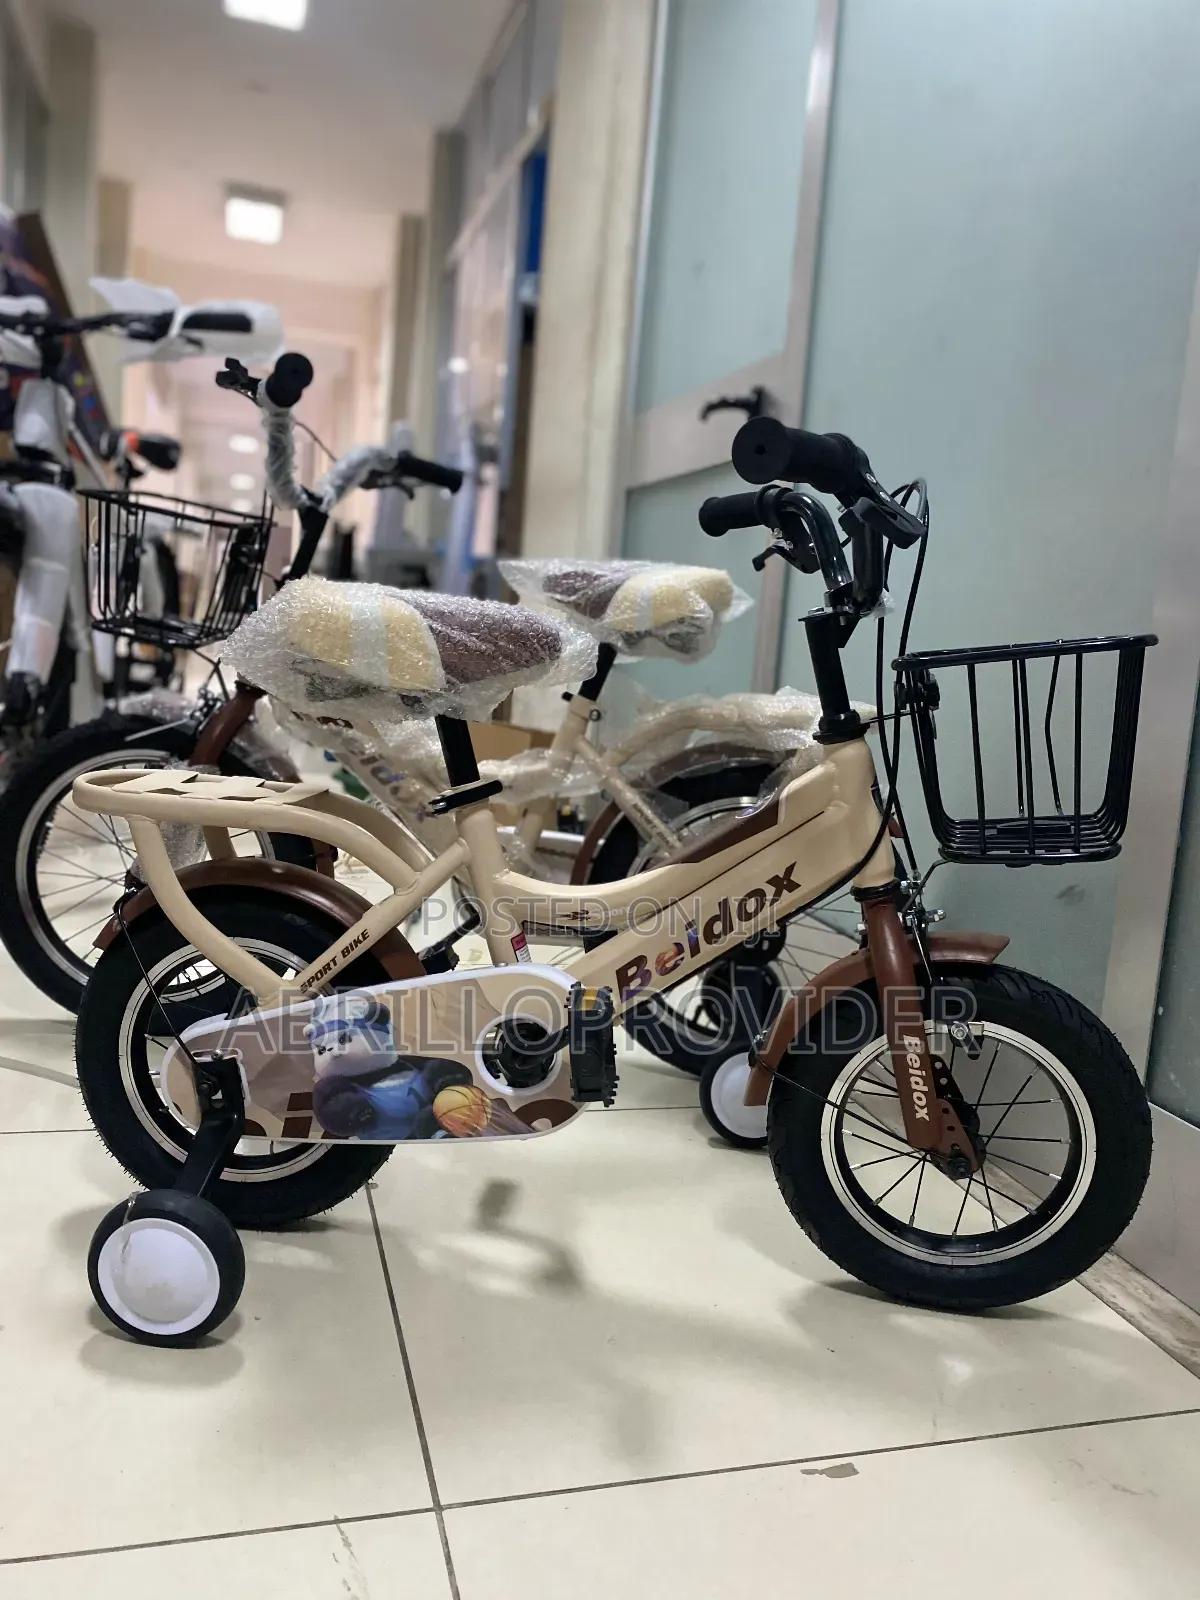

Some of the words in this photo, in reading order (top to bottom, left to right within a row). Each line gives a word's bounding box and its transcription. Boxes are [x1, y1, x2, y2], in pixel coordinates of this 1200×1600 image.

[300, 956, 338, 995] SPORT
[340, 929, 370, 958] BIKE
[615, 861, 802, 1004] Beidox
[903, 1034, 930, 1122] Beidox
